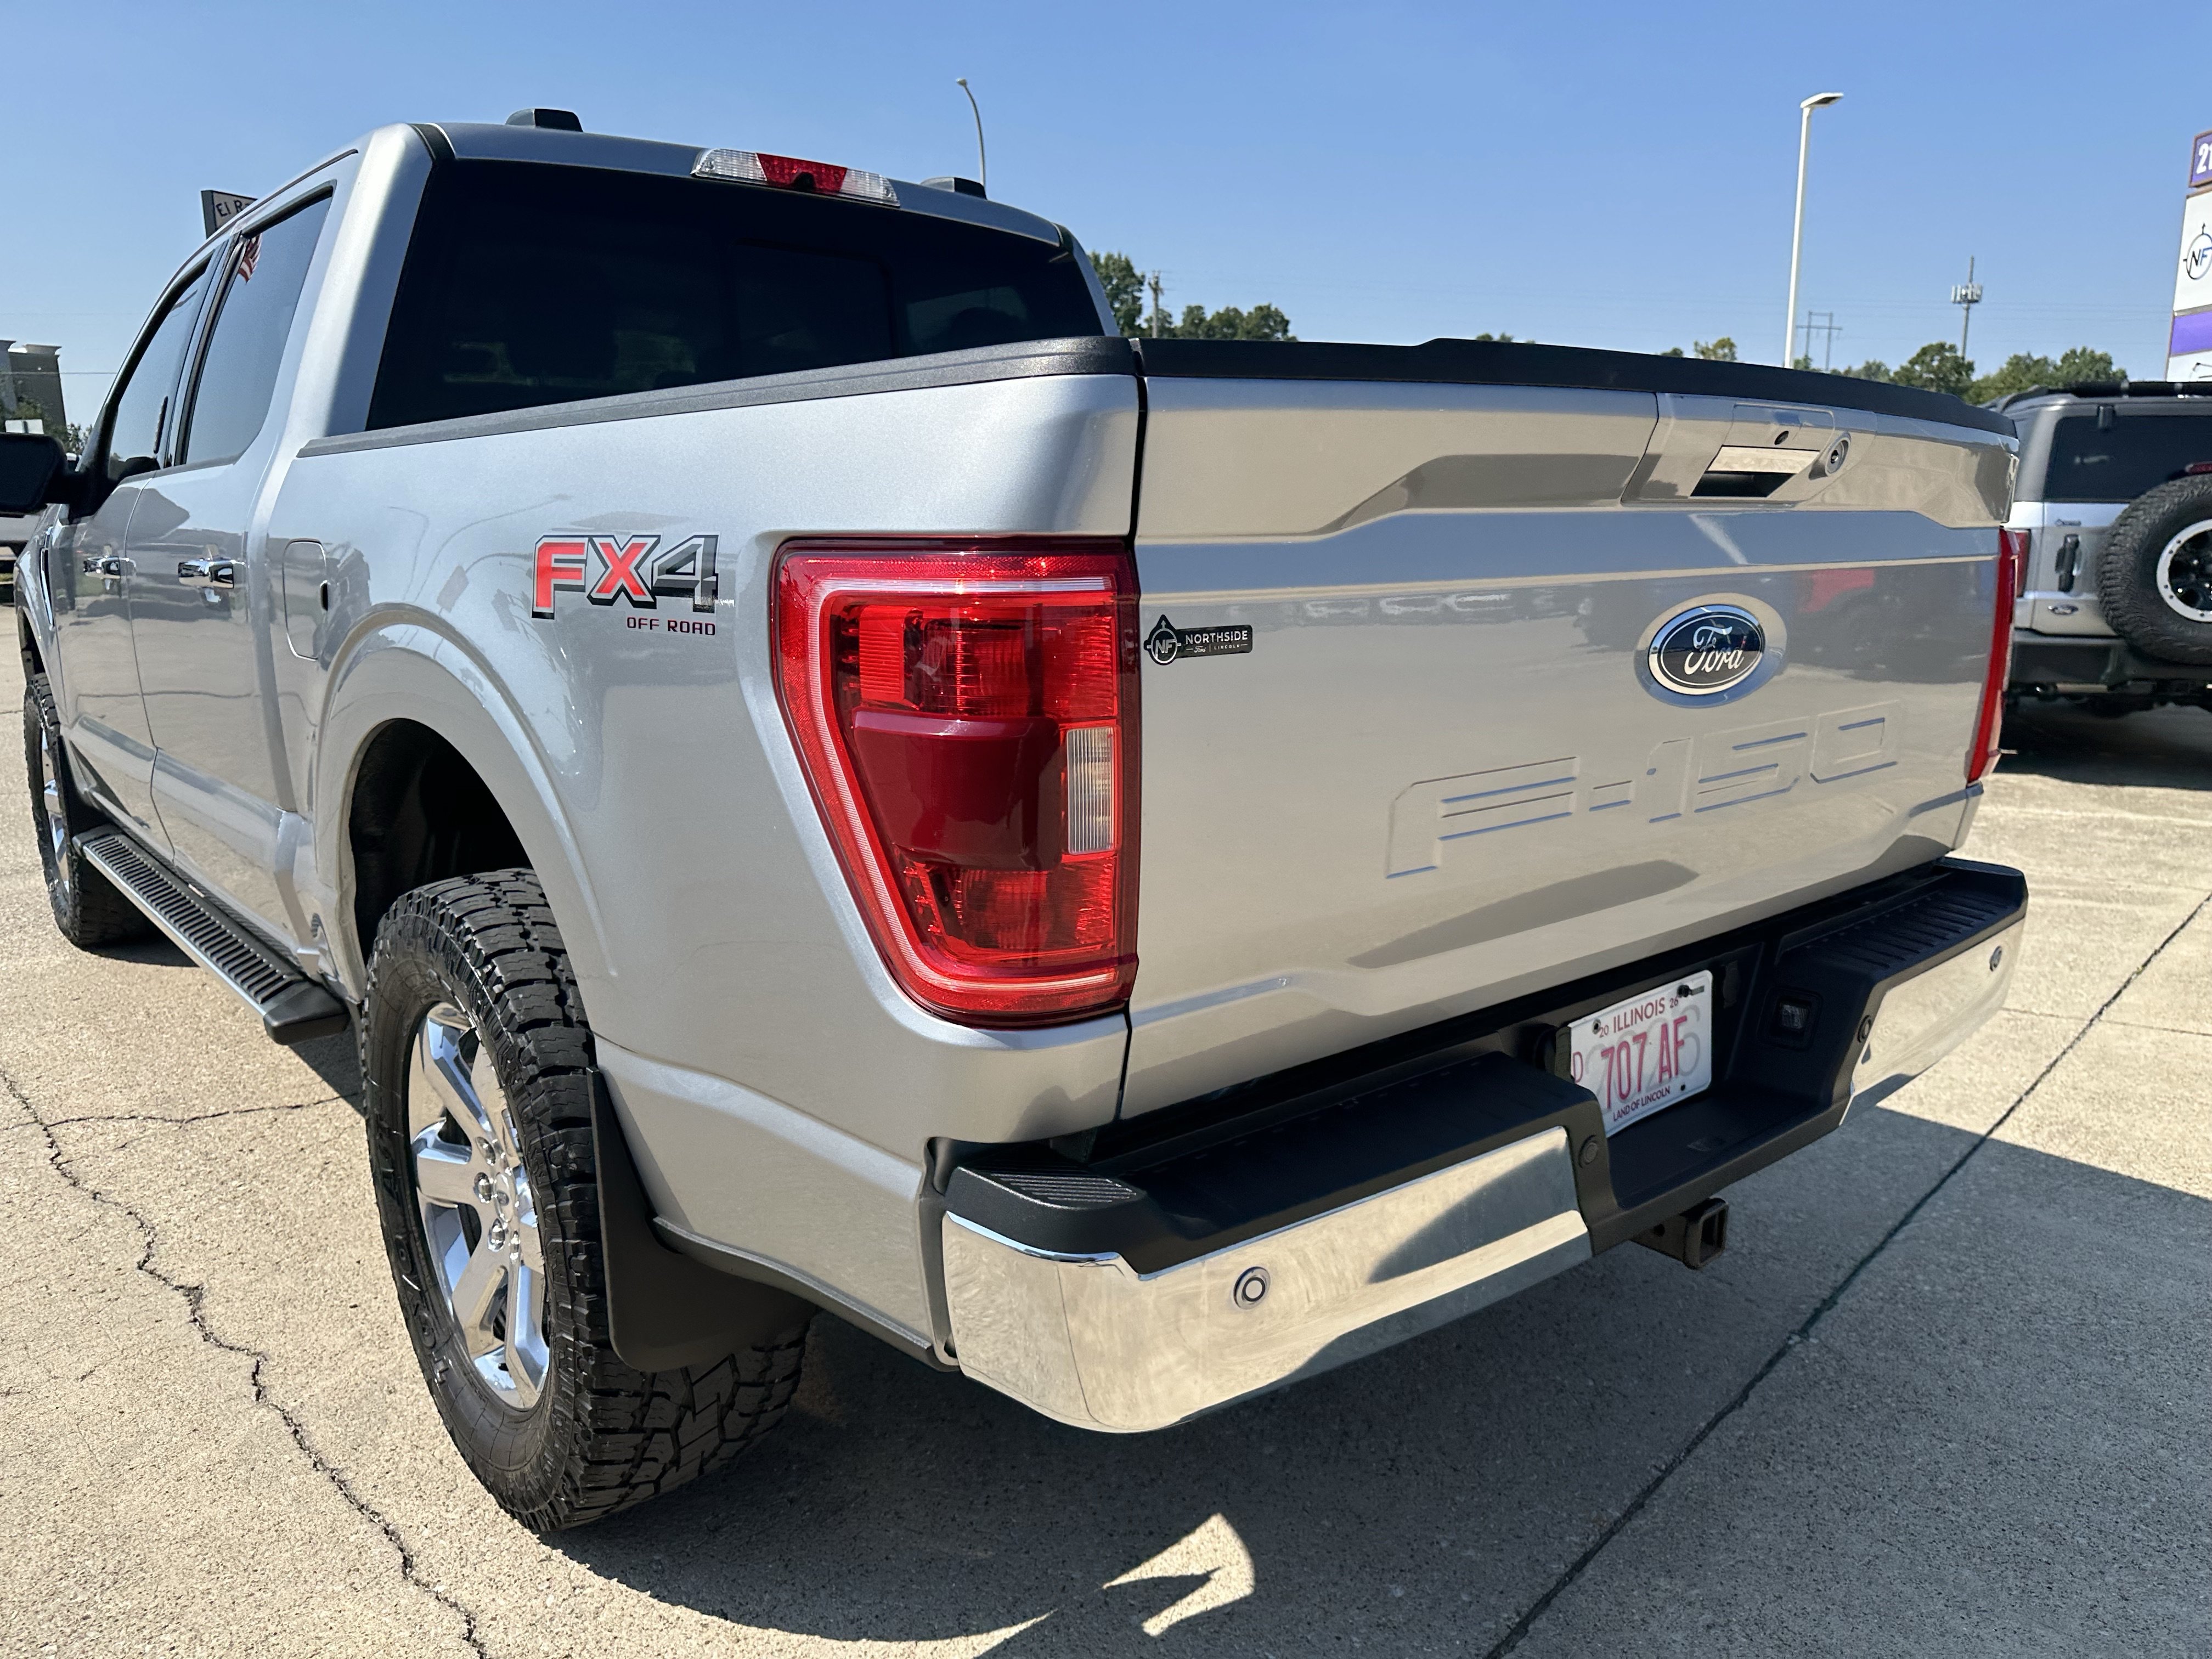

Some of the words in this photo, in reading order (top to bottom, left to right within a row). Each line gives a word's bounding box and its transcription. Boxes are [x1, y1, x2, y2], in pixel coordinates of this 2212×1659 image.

[532, 534, 719, 620] FX4
[627, 616, 659, 630] OFF
[667, 619, 716, 636] ROAD
[1185, 630, 1248, 645] NORTHSIDE
[1684, 625, 1745, 675] Ford
[1386, 700, 1903, 878] F-150
[1613, 997, 1666, 1034] ILLINOIS
[1600, 1031, 1648, 1110] 707
[1658, 1015, 1688, 1084] AF
[1613, 1103, 1630, 1122] LAND
[1630, 1098, 1641, 1111] OF
[1641, 1086, 1671, 1107] LINCOLN
